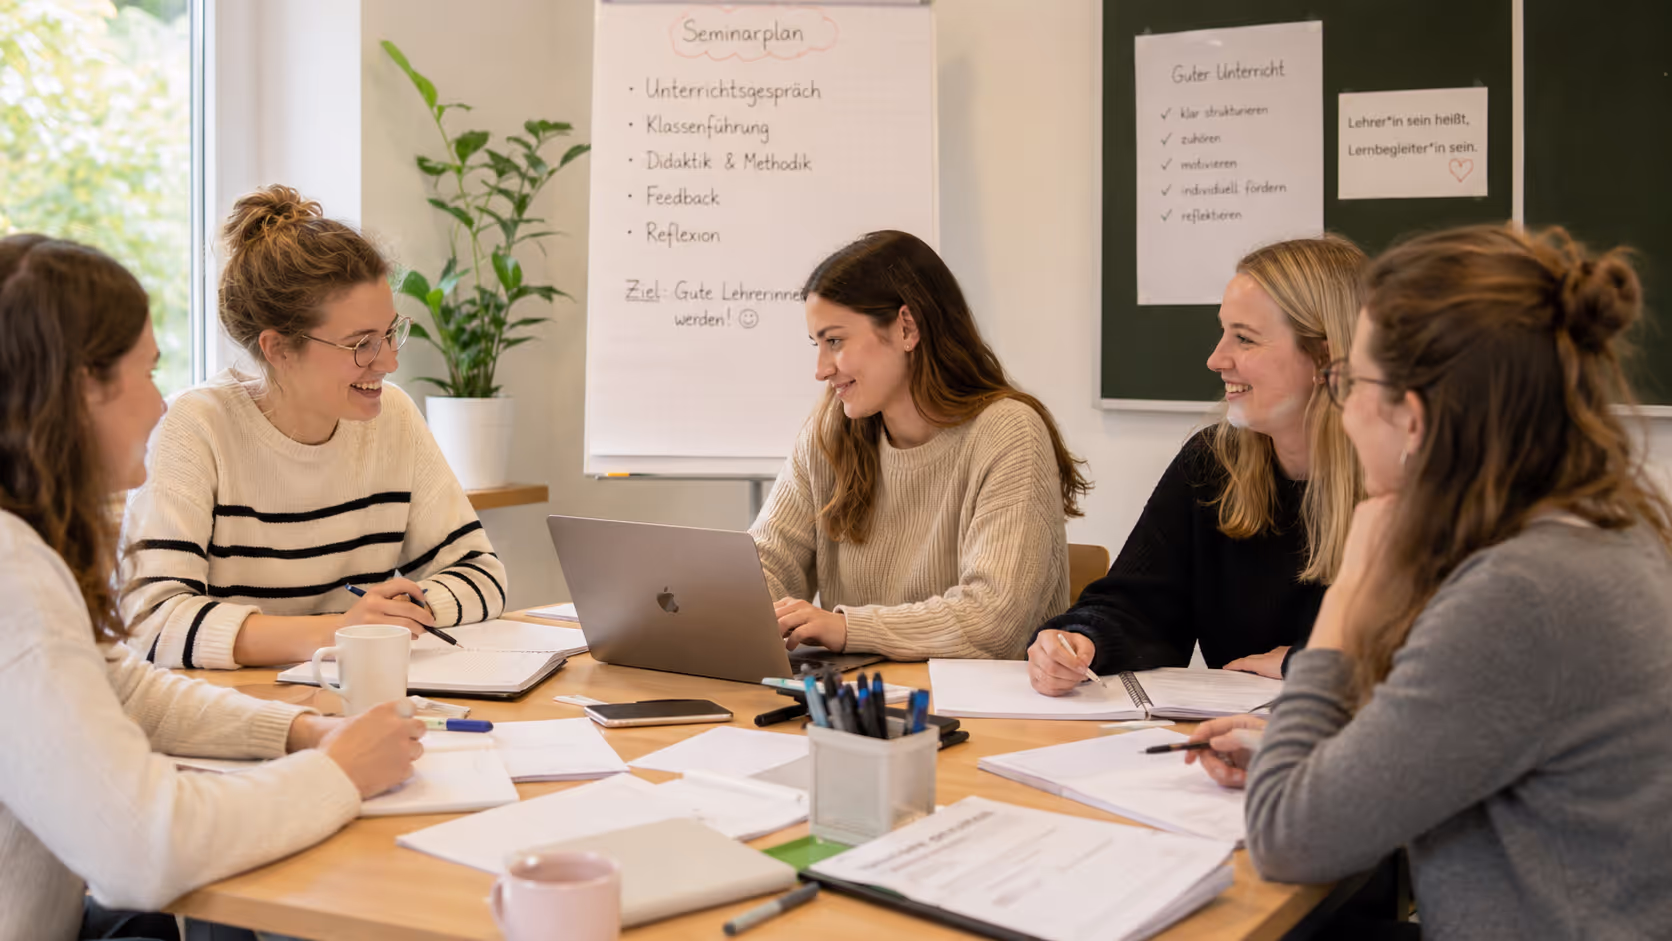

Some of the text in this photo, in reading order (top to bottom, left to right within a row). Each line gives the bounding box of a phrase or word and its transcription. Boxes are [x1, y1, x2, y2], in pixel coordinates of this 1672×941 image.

[683, 19, 803, 50] Seminarplan
[1172, 60, 1285, 84] Guter Unterricht
[646, 77, 821, 107] Unterrichtsgespräch
[1180, 105, 1268, 119] klar strukturieren
[1407, 115, 1431, 126] sein
[1435, 113, 1470, 126] heißt,
[647, 114, 769, 144] Klassenführung
[1181, 133, 1220, 145] zuhören
[1449, 141, 1477, 153] sein.
[646, 150, 812, 171] Didaktik & Methodik
[1181, 158, 1237, 169] motivieren
[647, 185, 720, 206] Feedback
[1181, 182, 1238, 196] individuell
[1182, 209, 1242, 224] reflektieren
[646, 221, 720, 248] Reflexion
[625, 279, 666, 302] Ziel:
[674, 280, 713, 300] Gute
[675, 308, 730, 327] werden!
